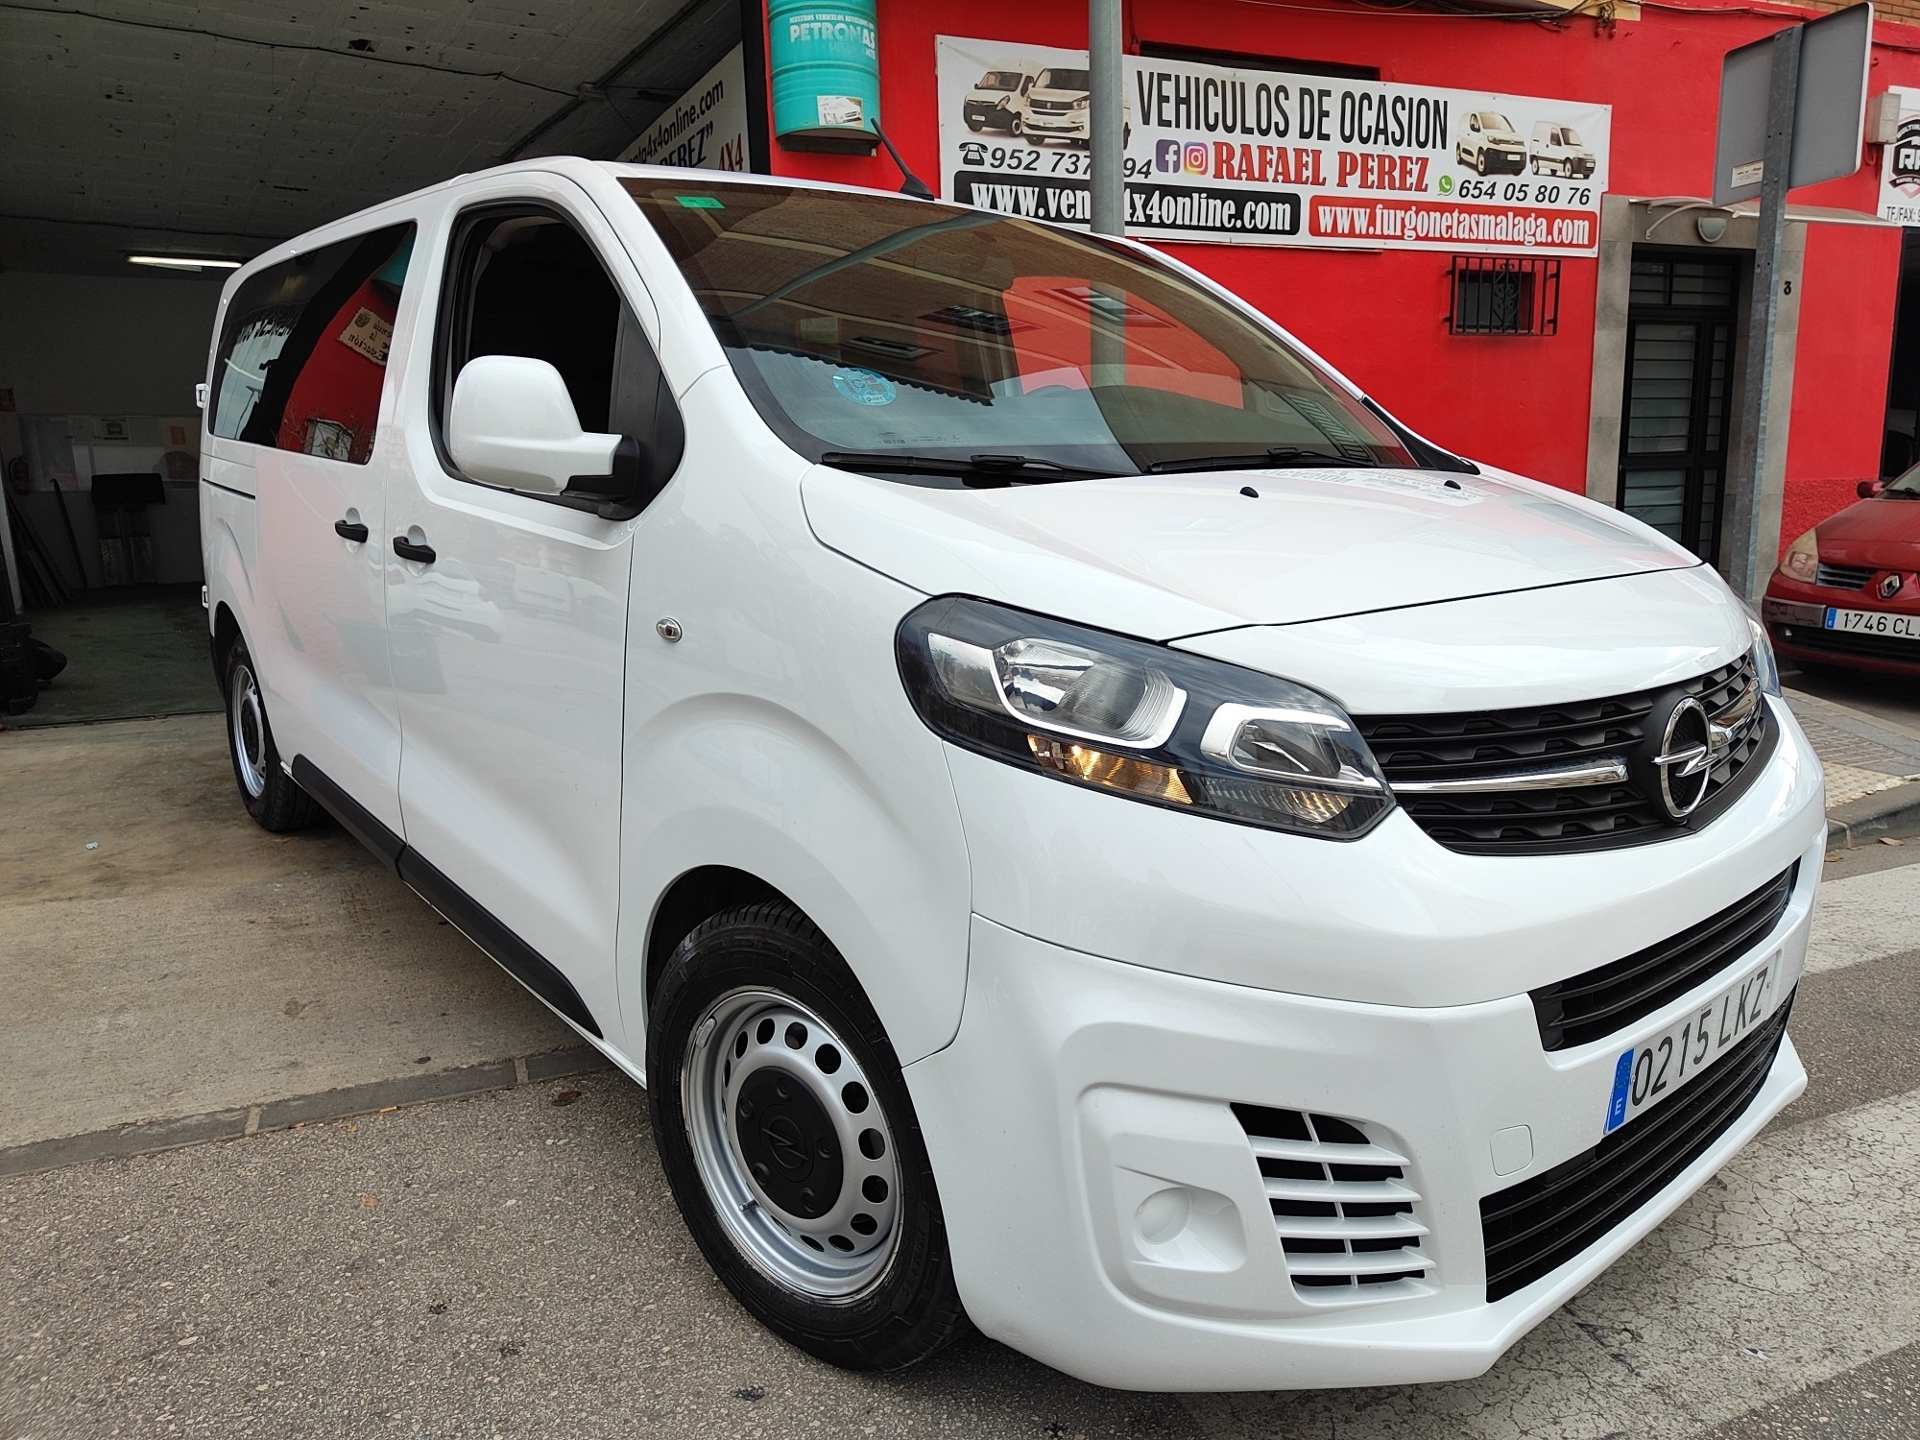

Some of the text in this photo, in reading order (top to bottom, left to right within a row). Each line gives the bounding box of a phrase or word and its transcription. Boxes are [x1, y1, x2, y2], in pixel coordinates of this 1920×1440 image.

[789, 22, 875, 49] PETRONAS
[1136, 69, 1448, 150] VEHICULOS DE OCASION
[989, 147, 1041, 172] 952
[1123, 157, 1153, 179] 94
[1212, 140, 1429, 192] RAFAEL PEREZ
[970, 182, 1291, 231] www.ven4x4online.com
[1458, 179, 1591, 206] 654 05 80 76
[1318, 203, 1590, 246] www.furgonetasmalaga.com
[1843, 612, 1920, 638] 1746 CL
[1631, 966, 1769, 1107] 0215 LKZ
[1614, 1097, 1622, 1117] E
